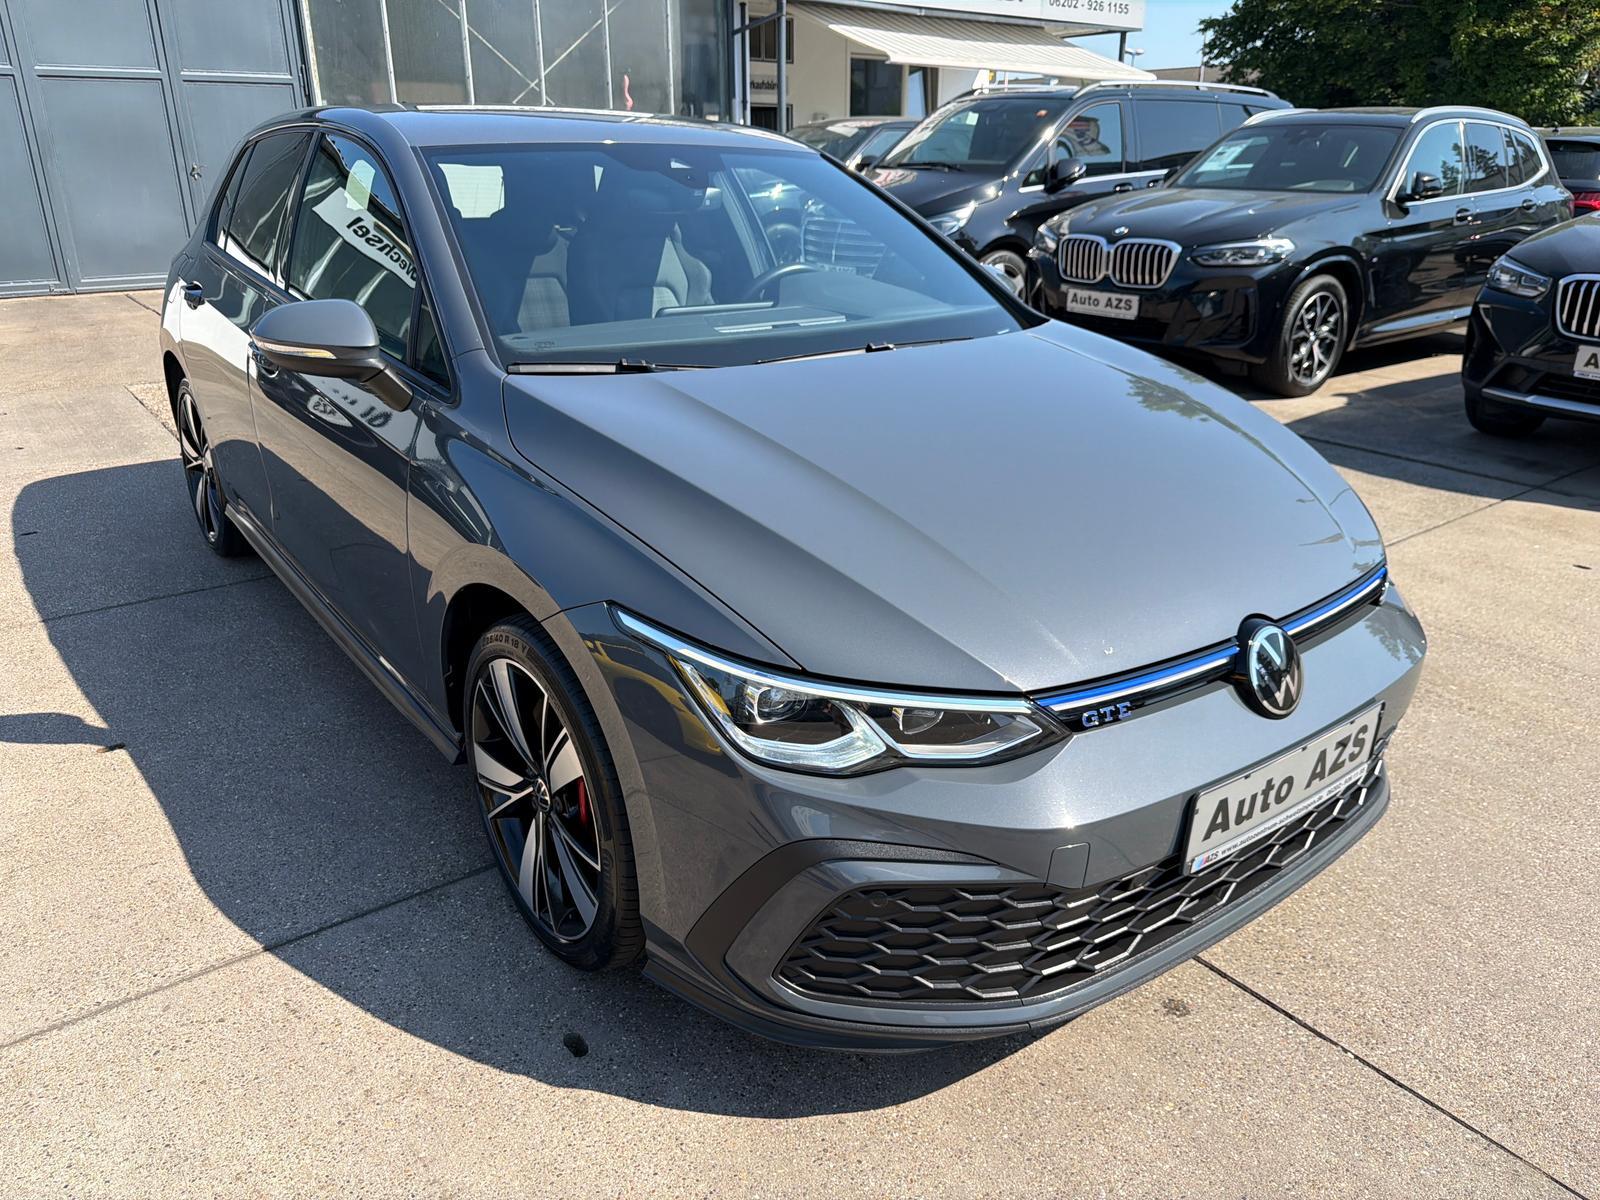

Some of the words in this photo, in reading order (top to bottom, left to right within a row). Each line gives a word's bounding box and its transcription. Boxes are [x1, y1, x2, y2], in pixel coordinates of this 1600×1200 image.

[1087, 2, 1104, 12] 926
[1107, 3, 1129, 14] 1155
[1070, 292, 1100, 307] Auto
[1105, 297, 1132, 311] AZS
[1584, 353, 1600, 369] A
[511, 638, 520, 649] 18
[1082, 702, 1132, 727] GTE
[1202, 775, 1295, 842] Auto
[1303, 724, 1369, 790] AZS
